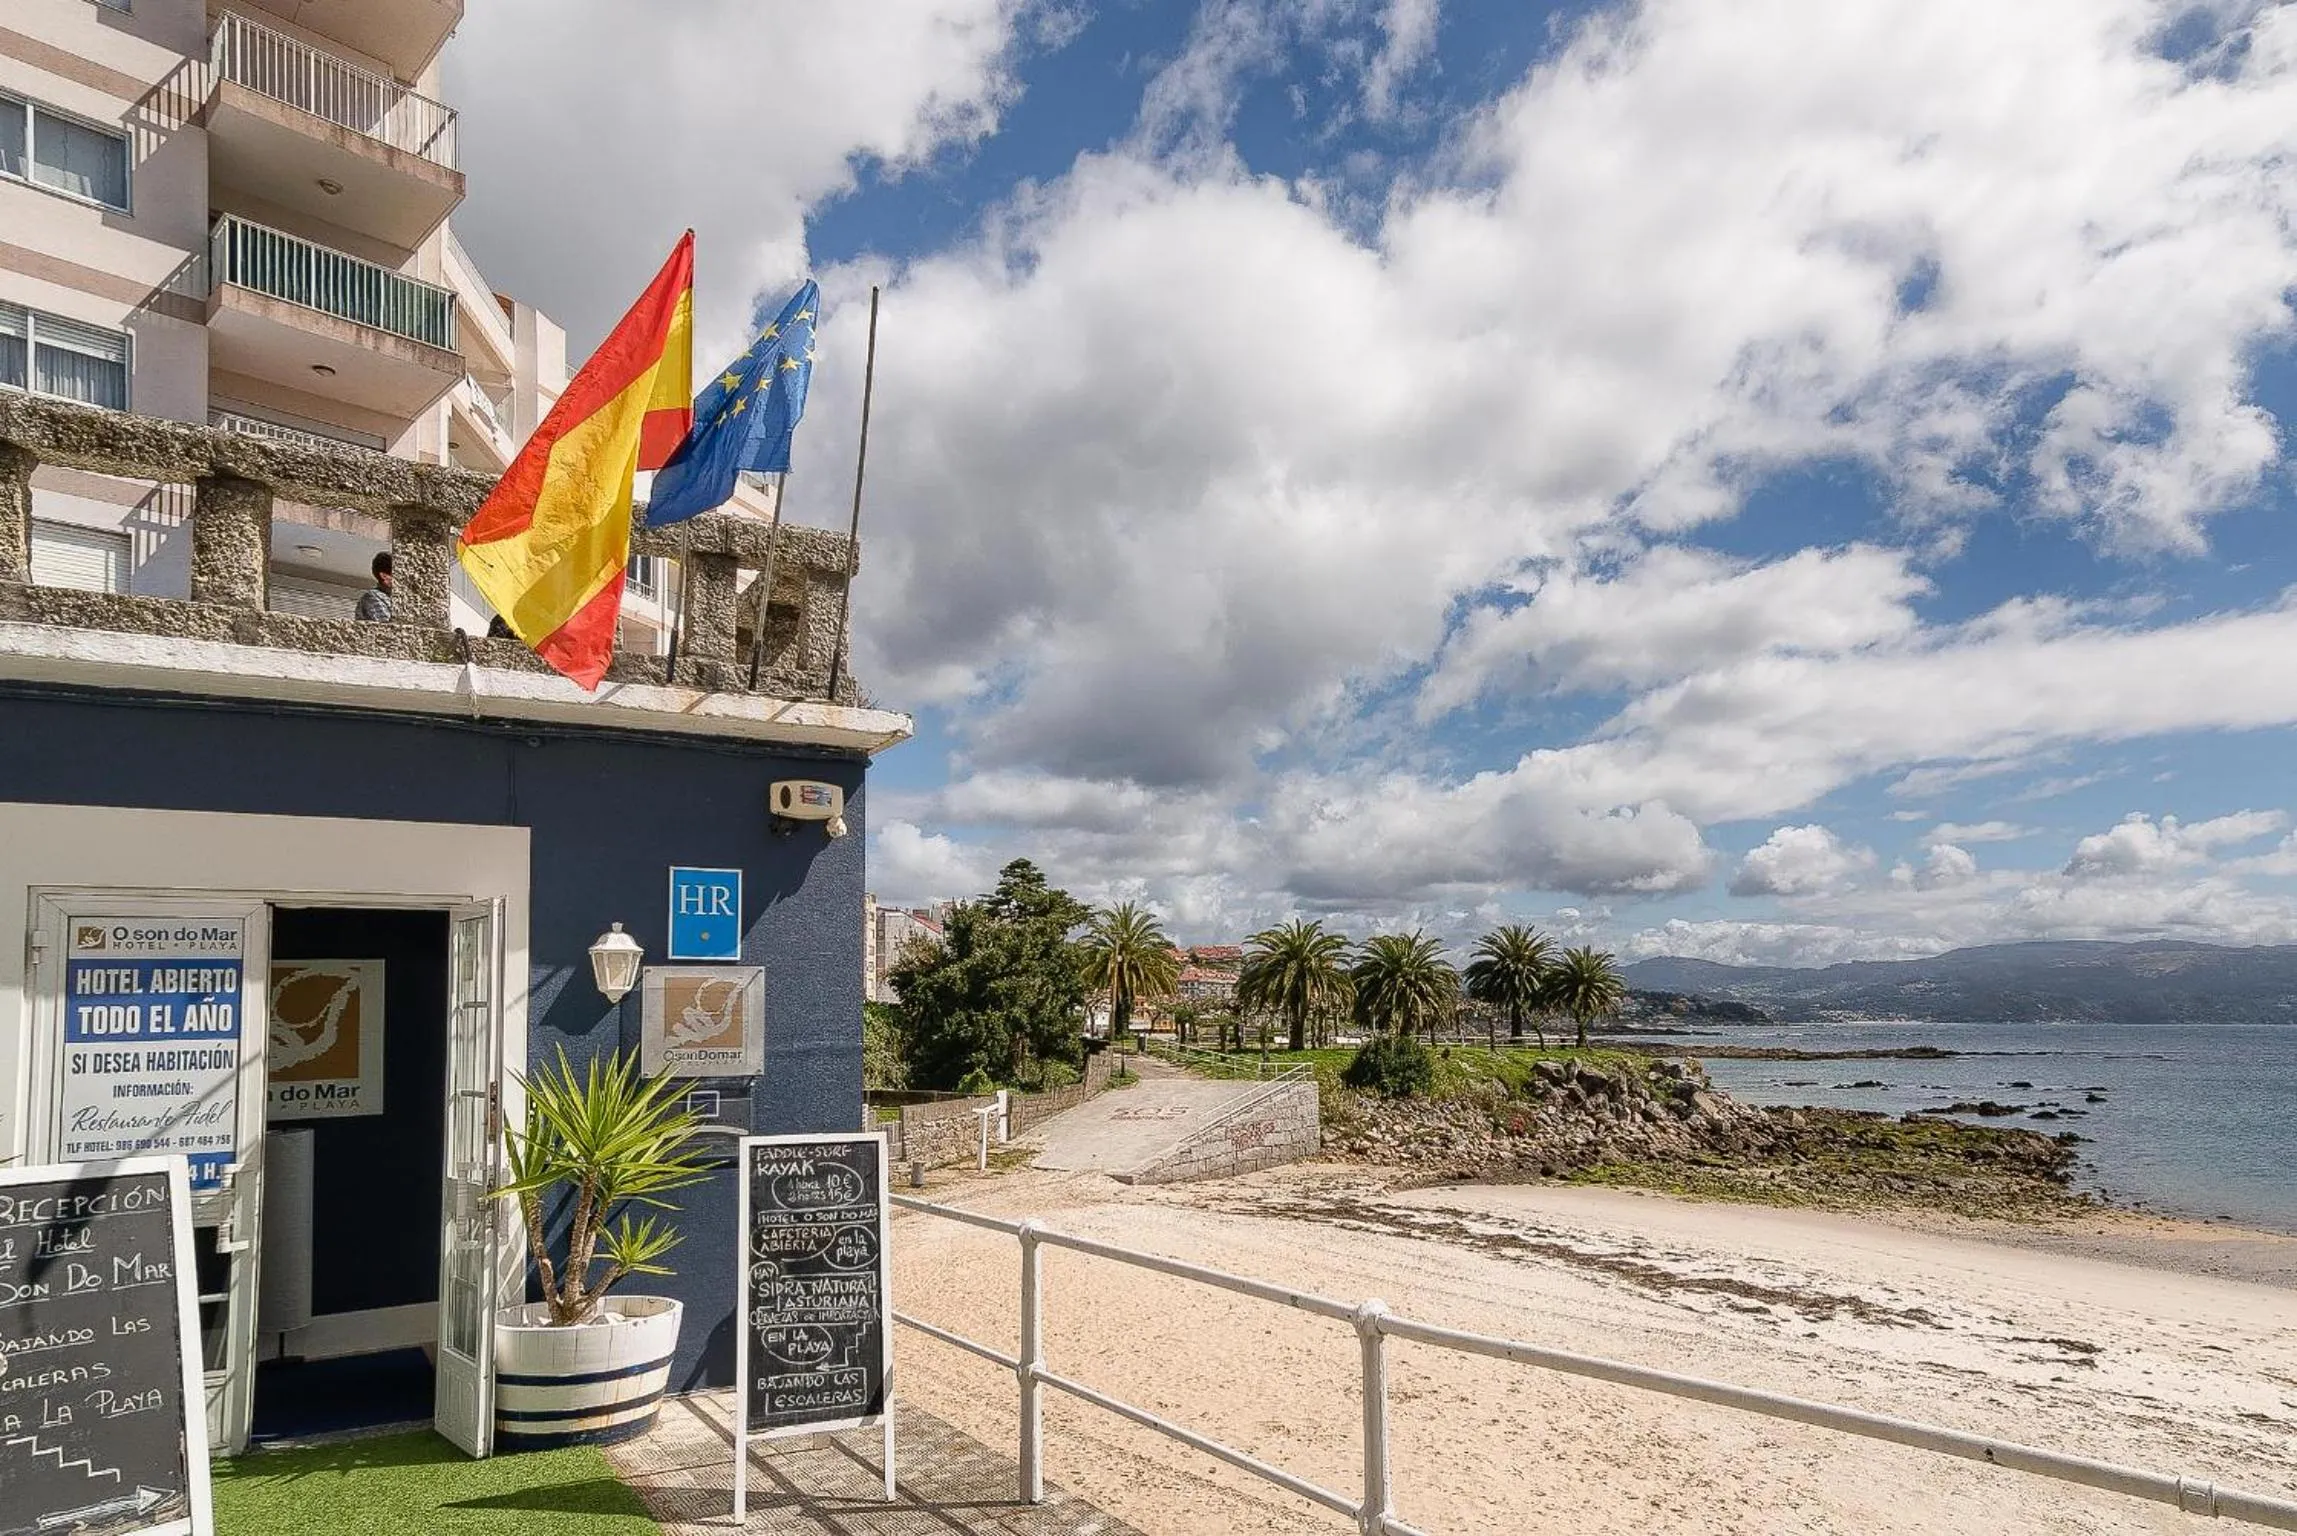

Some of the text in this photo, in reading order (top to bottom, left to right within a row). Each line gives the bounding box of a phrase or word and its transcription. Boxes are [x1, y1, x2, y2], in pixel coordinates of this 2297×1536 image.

[677, 883, 735, 917] HR
[112, 926, 238, 941] O son do Mar
[112, 941, 238, 950] HOTEL PLAYA
[76, 967, 237, 994] HOTEL ABIERTO
[77, 995, 233, 1034] TODO EL AÑO
[71, 1042, 233, 1074] SI DESEA HABITACIÓN
[112, 1079, 194, 1098] INFORMACIÓN:
[280, 1085, 310, 1101] do
[315, 1083, 361, 1100] Mar
[300, 1101, 360, 1110] PLAYA
[71, 1099, 234, 1132] Restaurante Fidel
[757, 1159, 815, 1176] KAYAK
[827, 1174, 840, 1189] 10
[762, 1214, 799, 1224] HOTEL
[804, 1213, 813, 1222] O
[815, 1211, 837, 1221] SON
[841, 1211, 858, 1220] DO
[36, 1226, 97, 1256] Hotel
[761, 1226, 833, 1240] CAFETERIA
[838, 1229, 868, 1245] en la
[760, 1239, 817, 1253] ABIERTA
[836, 1244, 870, 1264] playa
[754, 1266, 775, 1280] HAY
[758, 1278, 877, 1298] SIDRA NATURAL
[784, 1295, 870, 1308] ASTURIANA
[767, 1327, 809, 1343] EN LA
[788, 1341, 831, 1356] PLAYA
[757, 1374, 825, 1390] BAJANDO
[85, 1388, 165, 1414] PLAYA
[775, 1389, 863, 1407] ESCALERAS
